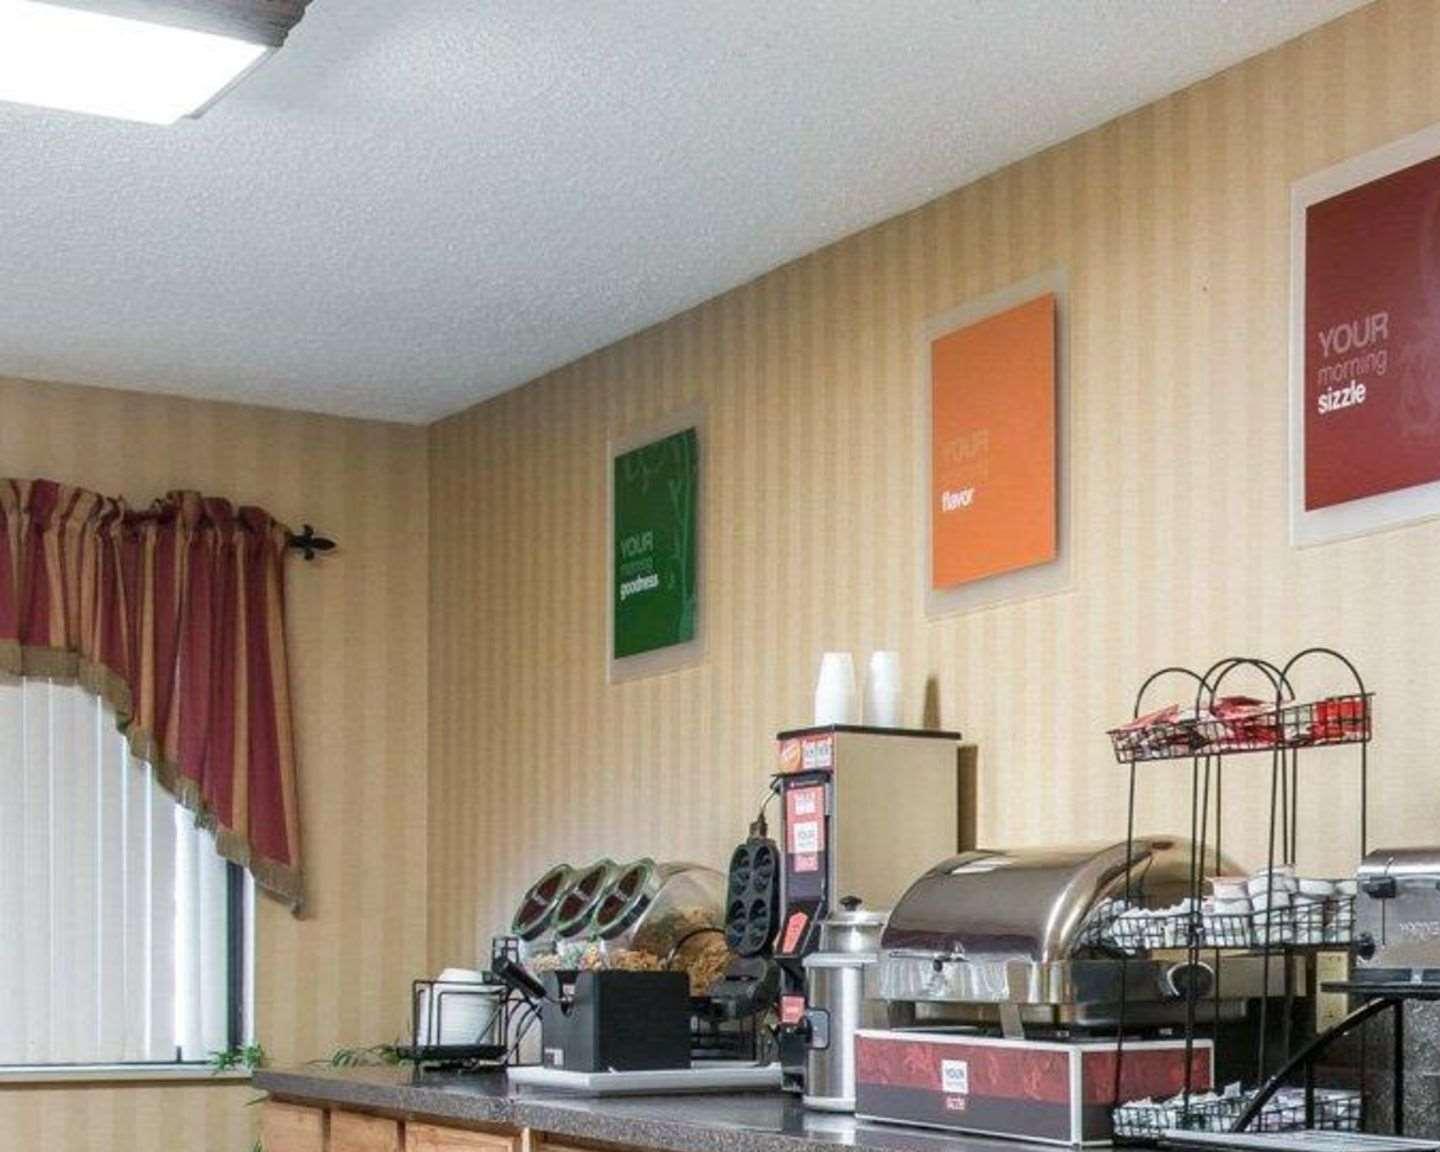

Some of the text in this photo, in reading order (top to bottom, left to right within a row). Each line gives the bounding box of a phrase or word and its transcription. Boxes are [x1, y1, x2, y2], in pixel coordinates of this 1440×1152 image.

[1318, 312, 1388, 357] YOUR
[1318, 350, 1387, 385] morning
[1318, 379, 1367, 414] sizzle
